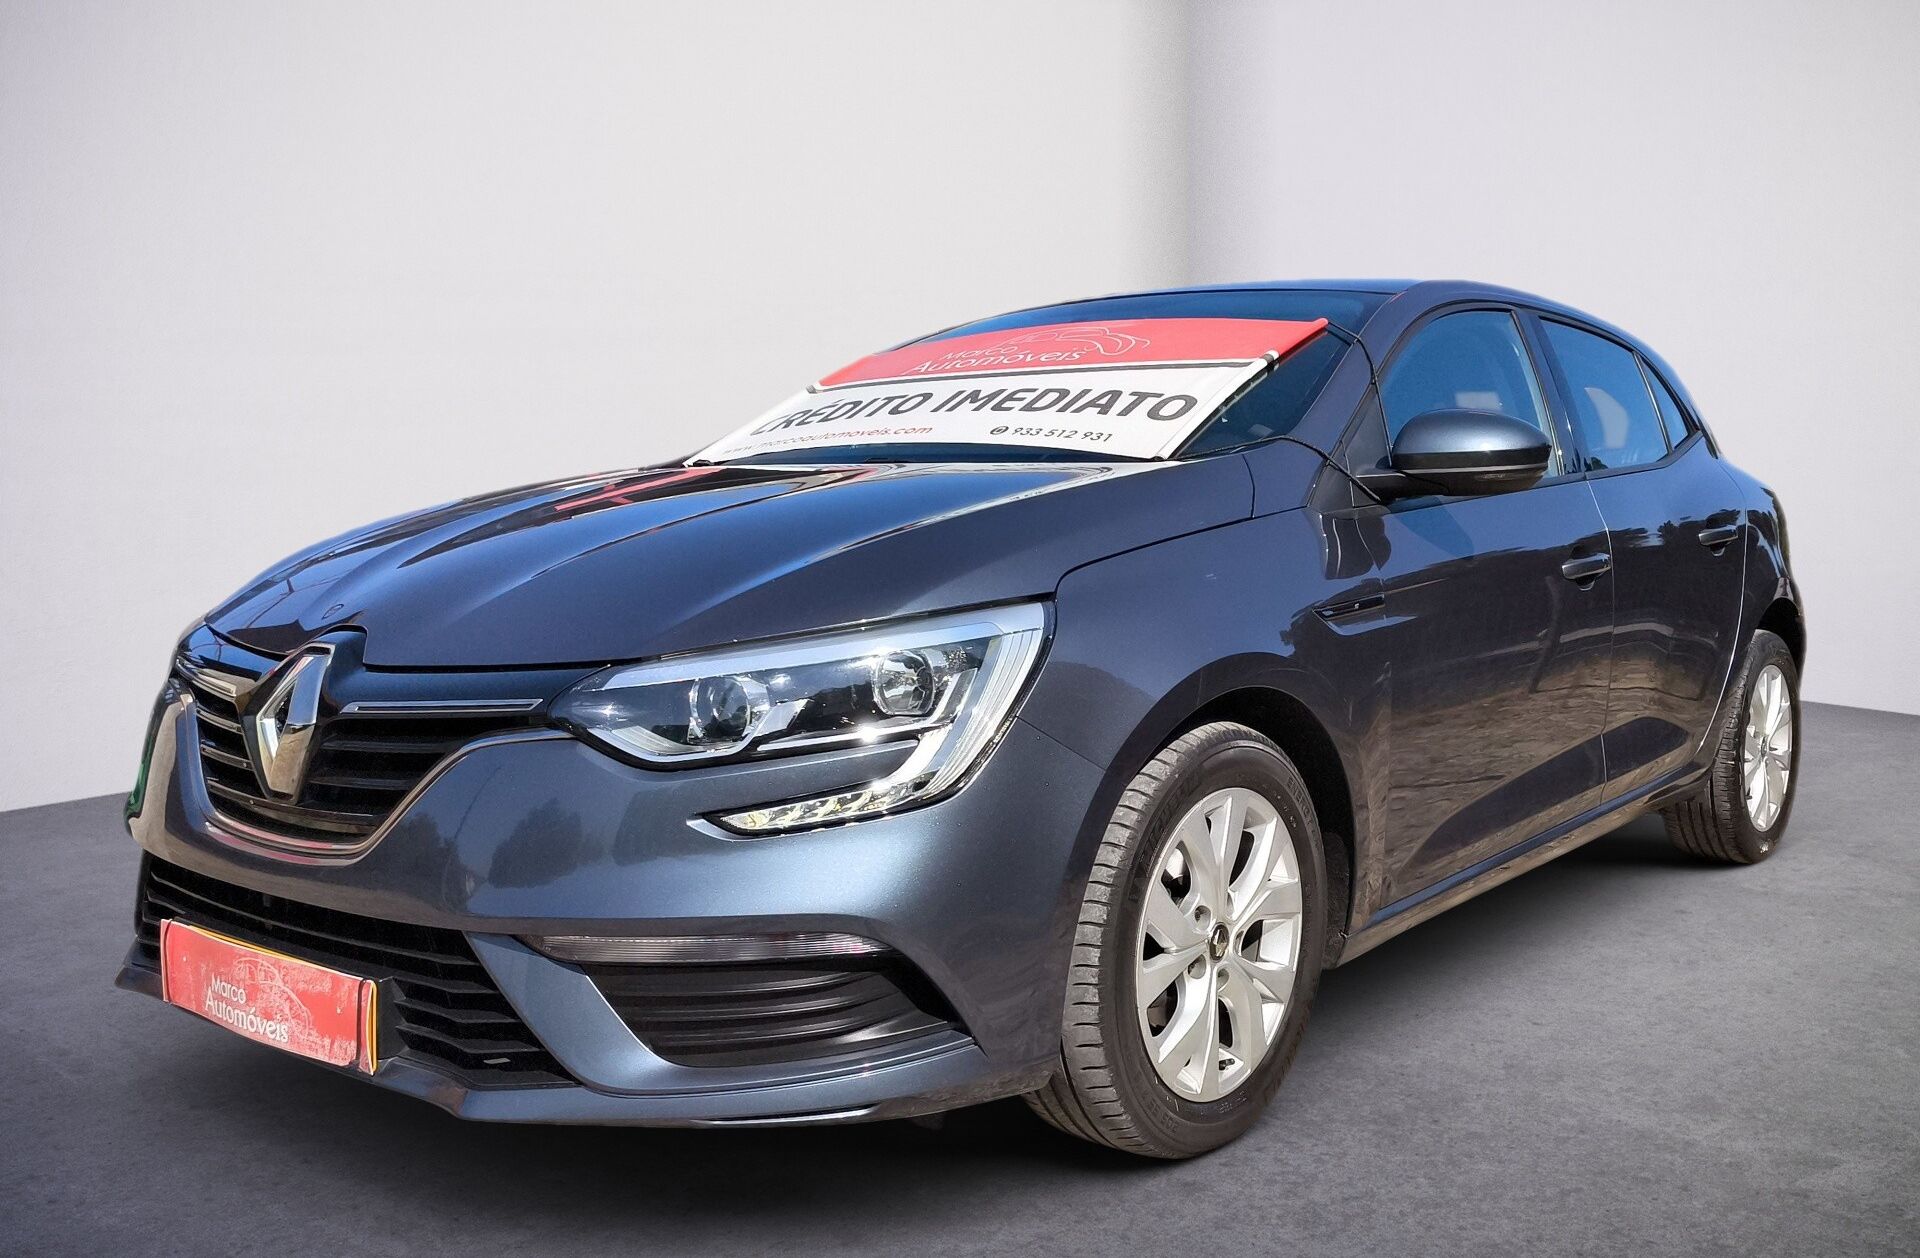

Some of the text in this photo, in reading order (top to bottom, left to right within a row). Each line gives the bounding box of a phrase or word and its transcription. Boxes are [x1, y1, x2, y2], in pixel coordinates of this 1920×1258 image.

[902, 348, 1088, 375] Automóveis
[939, 345, 1019, 361] Marco
[750, 388, 1198, 436] CRÉDITO IMEDIATO
[1011, 427, 1113, 442] 933 512 931
[211, 971, 247, 1004] Marco
[205, 986, 289, 1043] Automóveis
